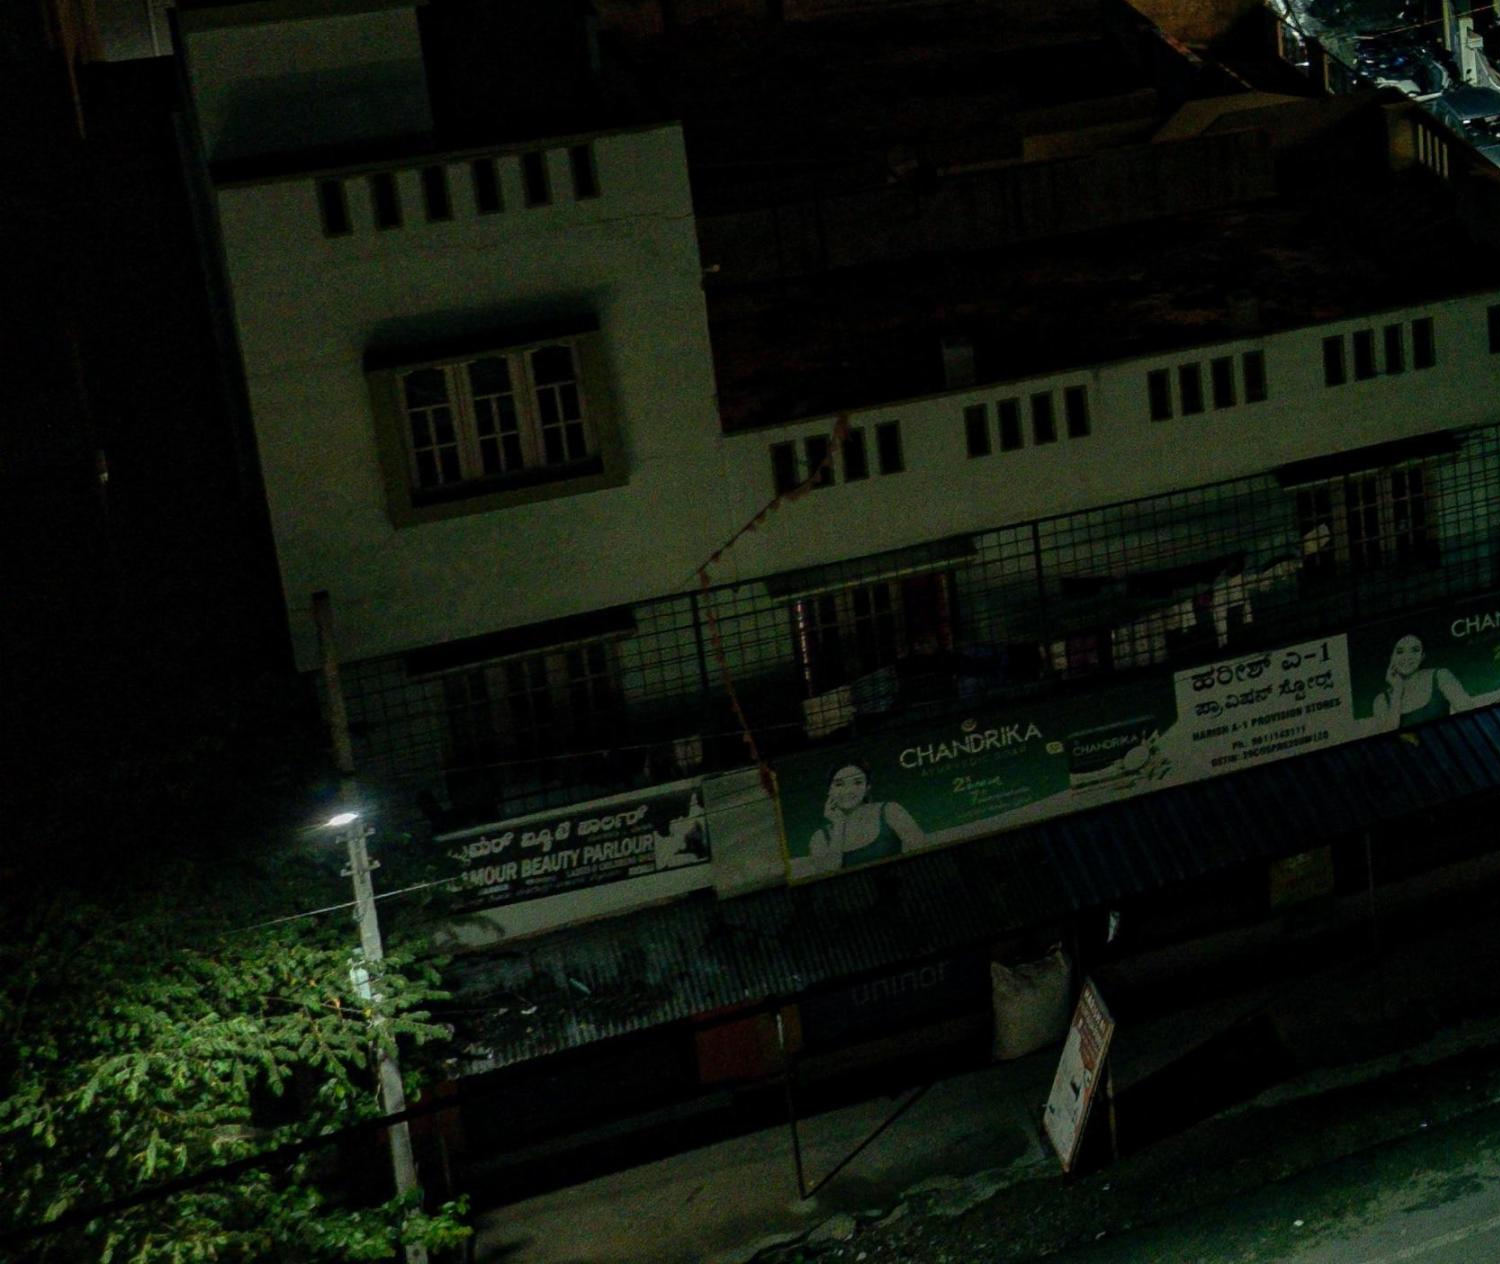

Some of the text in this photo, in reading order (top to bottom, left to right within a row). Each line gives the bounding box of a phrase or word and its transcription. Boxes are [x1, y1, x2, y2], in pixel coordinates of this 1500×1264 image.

[1250, 707, 1303, 728] PROVISION
[1304, 697, 1341, 714] STORES
[898, 721, 1043, 770] CHANDRIKA
[520, 846, 581, 878] BEAUTY
[582, 832, 655, 866] PARLOUR
